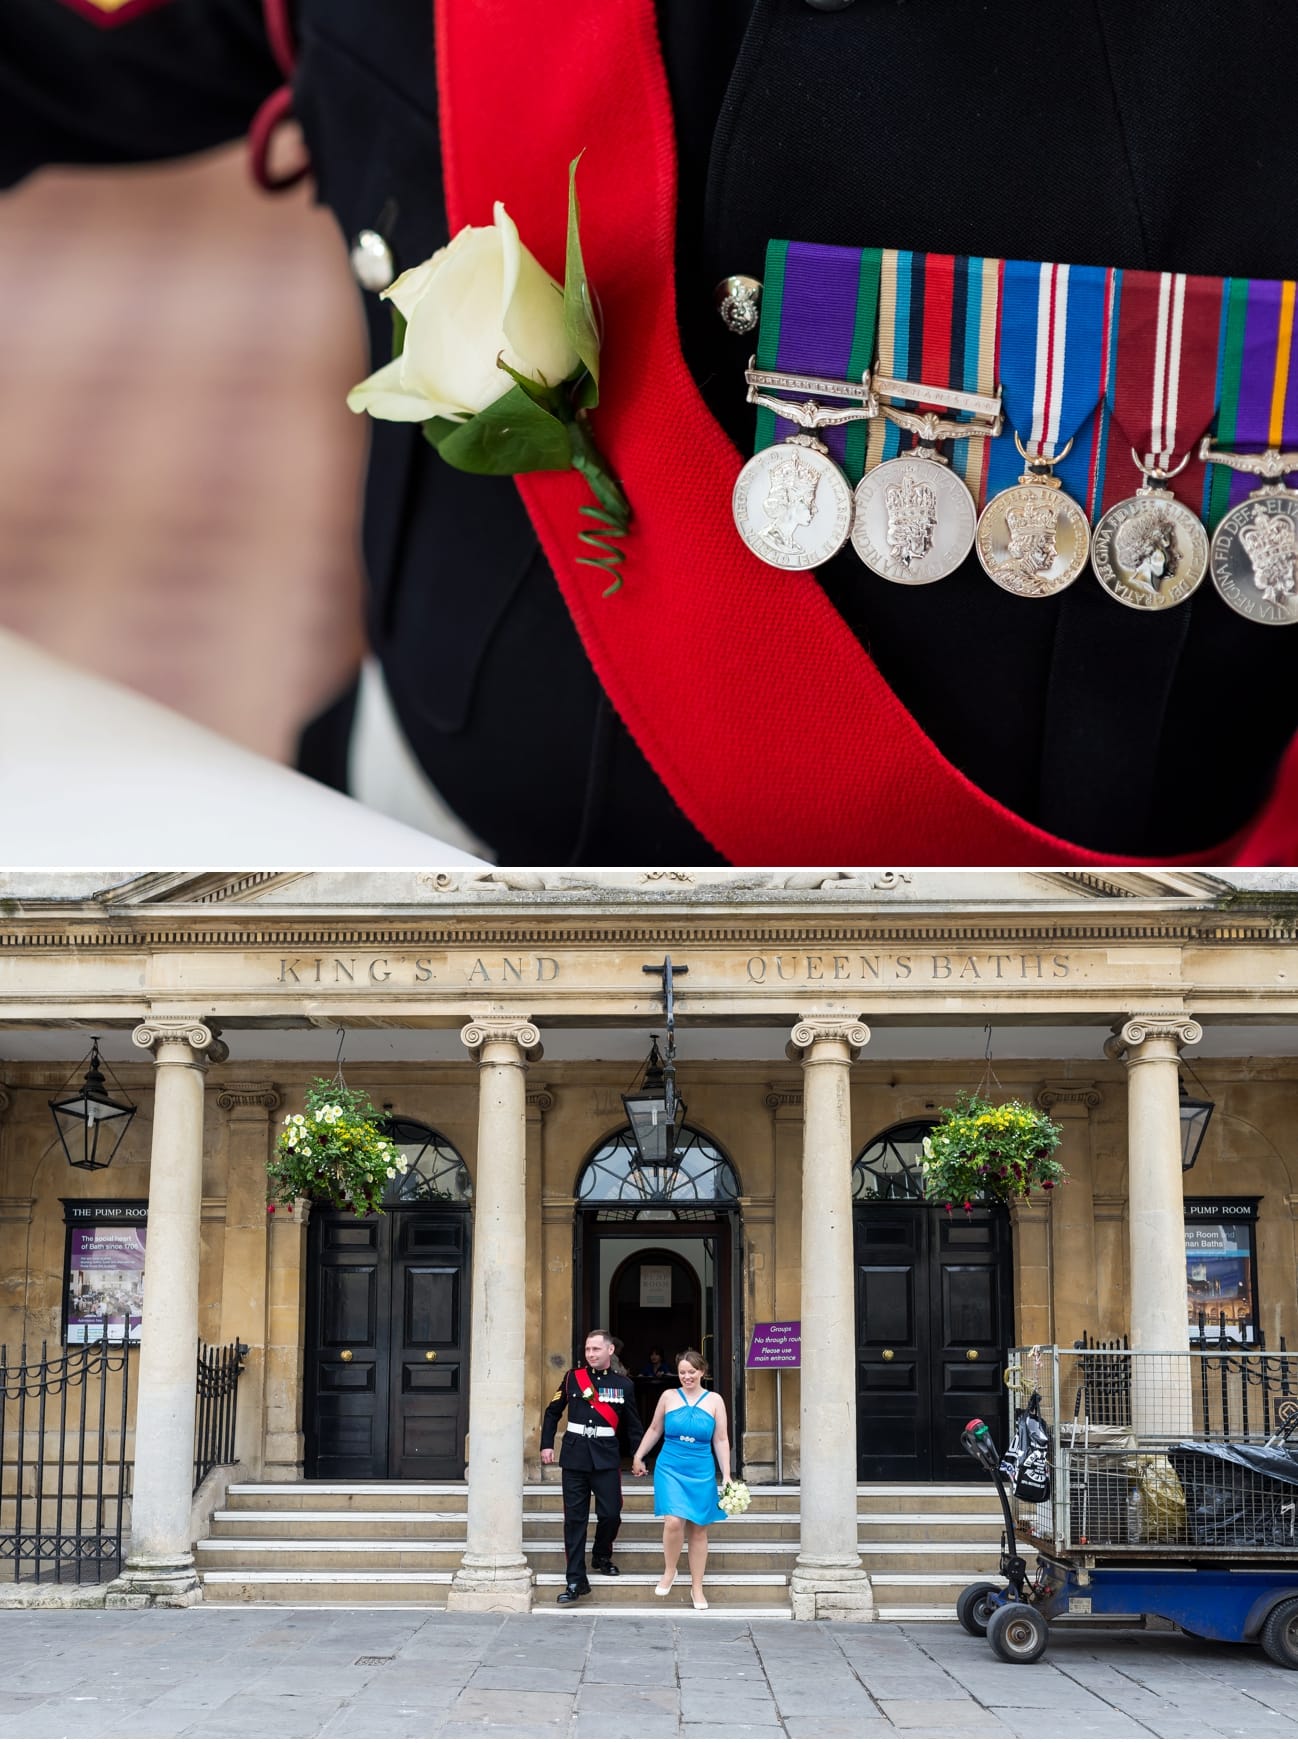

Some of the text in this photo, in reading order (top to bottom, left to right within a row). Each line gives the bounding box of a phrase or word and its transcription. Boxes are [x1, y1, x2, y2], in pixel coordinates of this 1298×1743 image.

[749, 374, 864, 396] NORTHERN IRELAND
[1216, 562, 1256, 613] REGINA
[279, 954, 1070, 985] KING'S AND QUEEN'S BATHS
[73, 1208, 92, 1217] THE
[95, 1208, 122, 1217] PUMP
[1190, 1206, 1219, 1214] PUMP
[1222, 1206, 1251, 1214] ROOM
[765, 1336, 787, 1344] through
